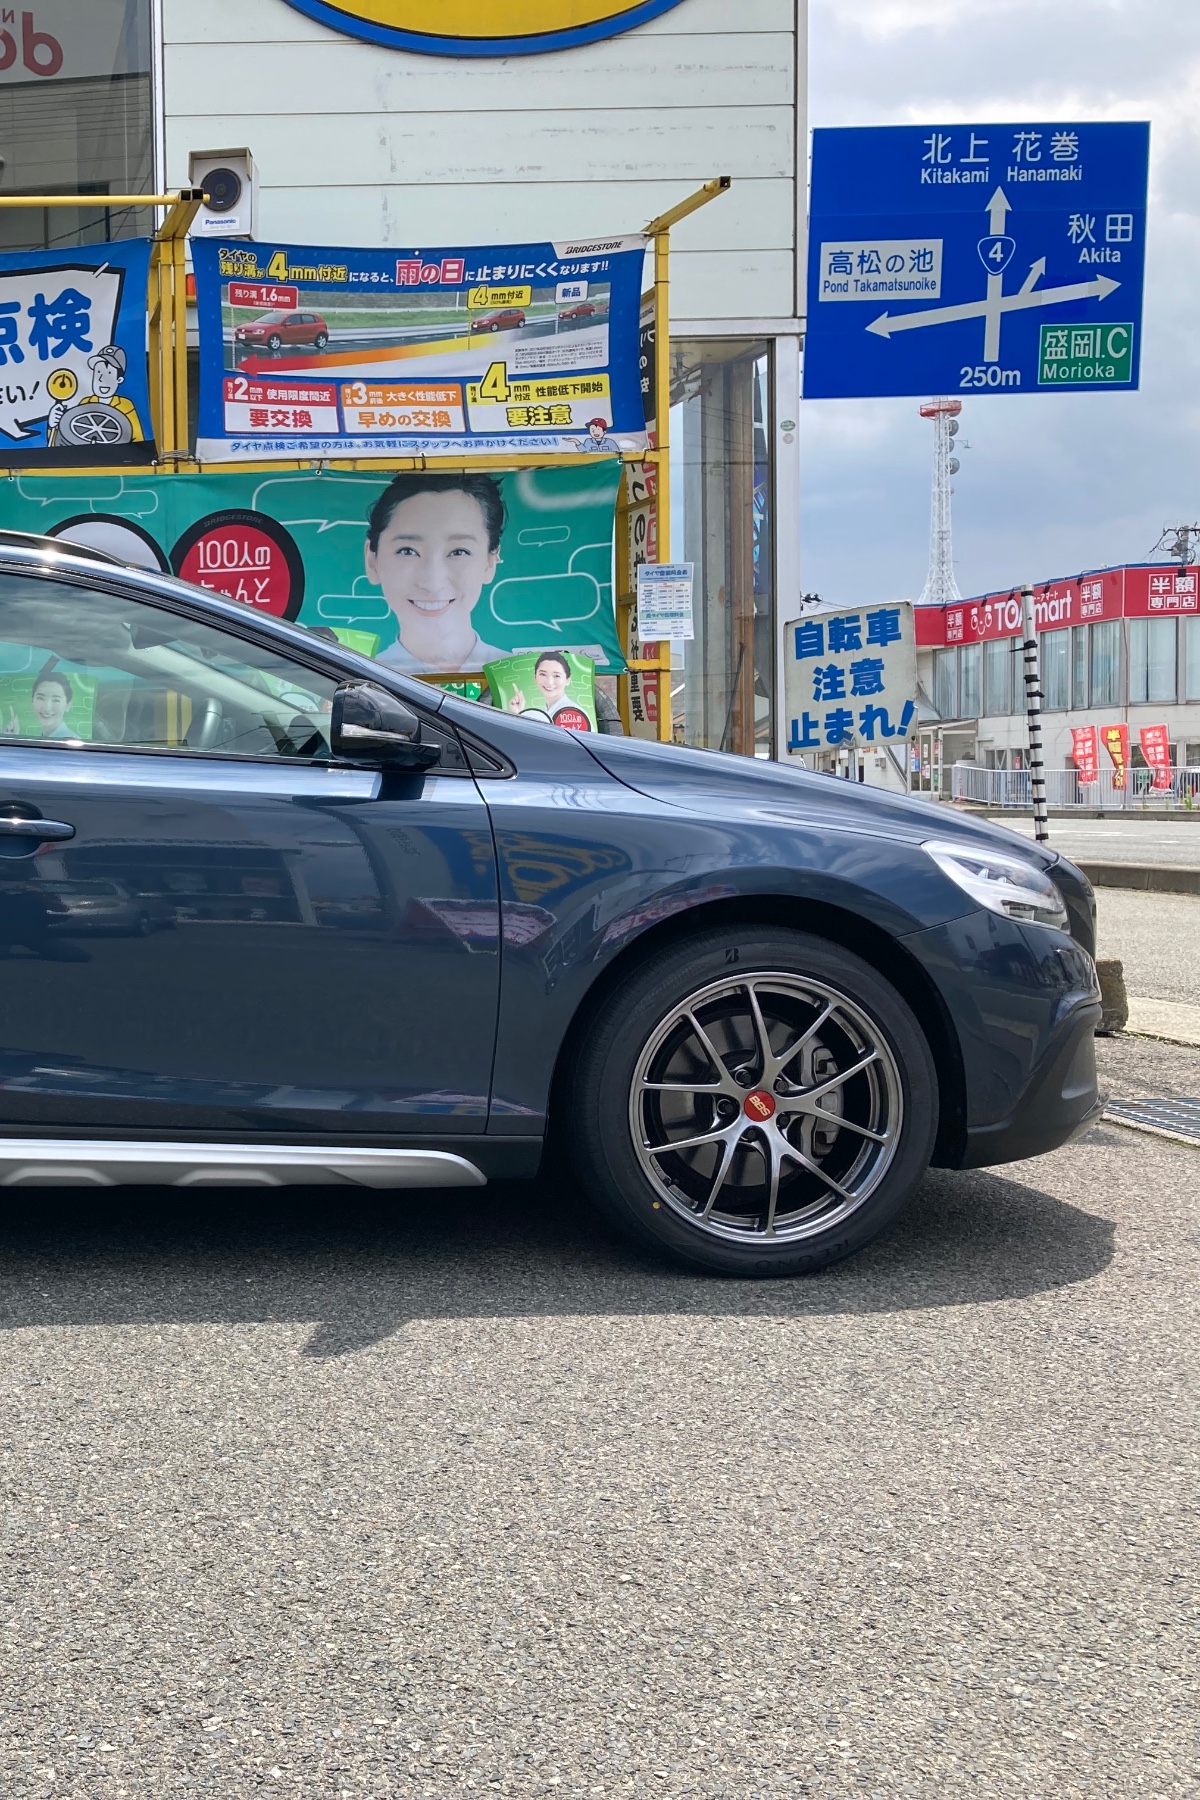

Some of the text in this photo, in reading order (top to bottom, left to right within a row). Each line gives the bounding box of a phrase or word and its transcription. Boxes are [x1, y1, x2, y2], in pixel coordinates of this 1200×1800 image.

[921, 131, 1080, 165] 北上 花巻
[920, 165, 1083, 184] Kitakami Hanamaki
[1067, 213, 1134, 244] 秋田
[218, 248, 257, 263] タイヤの
[564, 240, 624, 255] BRIDGESTONE
[988, 242, 1005, 263] 4
[1078, 247, 1122, 264] Akita
[828, 249, 934, 276] 高松の池
[260, 287, 291, 303] 1.6mm
[561, 287, 581, 298] 新品
[823, 277, 937, 294] Pond Takamatsunoike
[480, 361, 511, 403] 4
[535, 380, 603, 398] 性能低下開始
[959, 366, 1022, 388] 250m
[1043, 363, 1116, 380] Morioka
[386, 390, 457, 403] 大きく性能低下
[249, 408, 313, 429] 要交換
[358, 409, 452, 429] 早めの交換
[505, 403, 573, 428] 要注意
[197, 539, 271, 569] 100人の
[1151, 576, 1195, 594] 半額
[1151, 596, 1196, 609] 専門店
[794, 608, 902, 660] 自転車
[812, 657, 885, 702] 注意
[787, 699, 915, 750] 止まれ!
[749, 1095, 771, 1117] BBS
